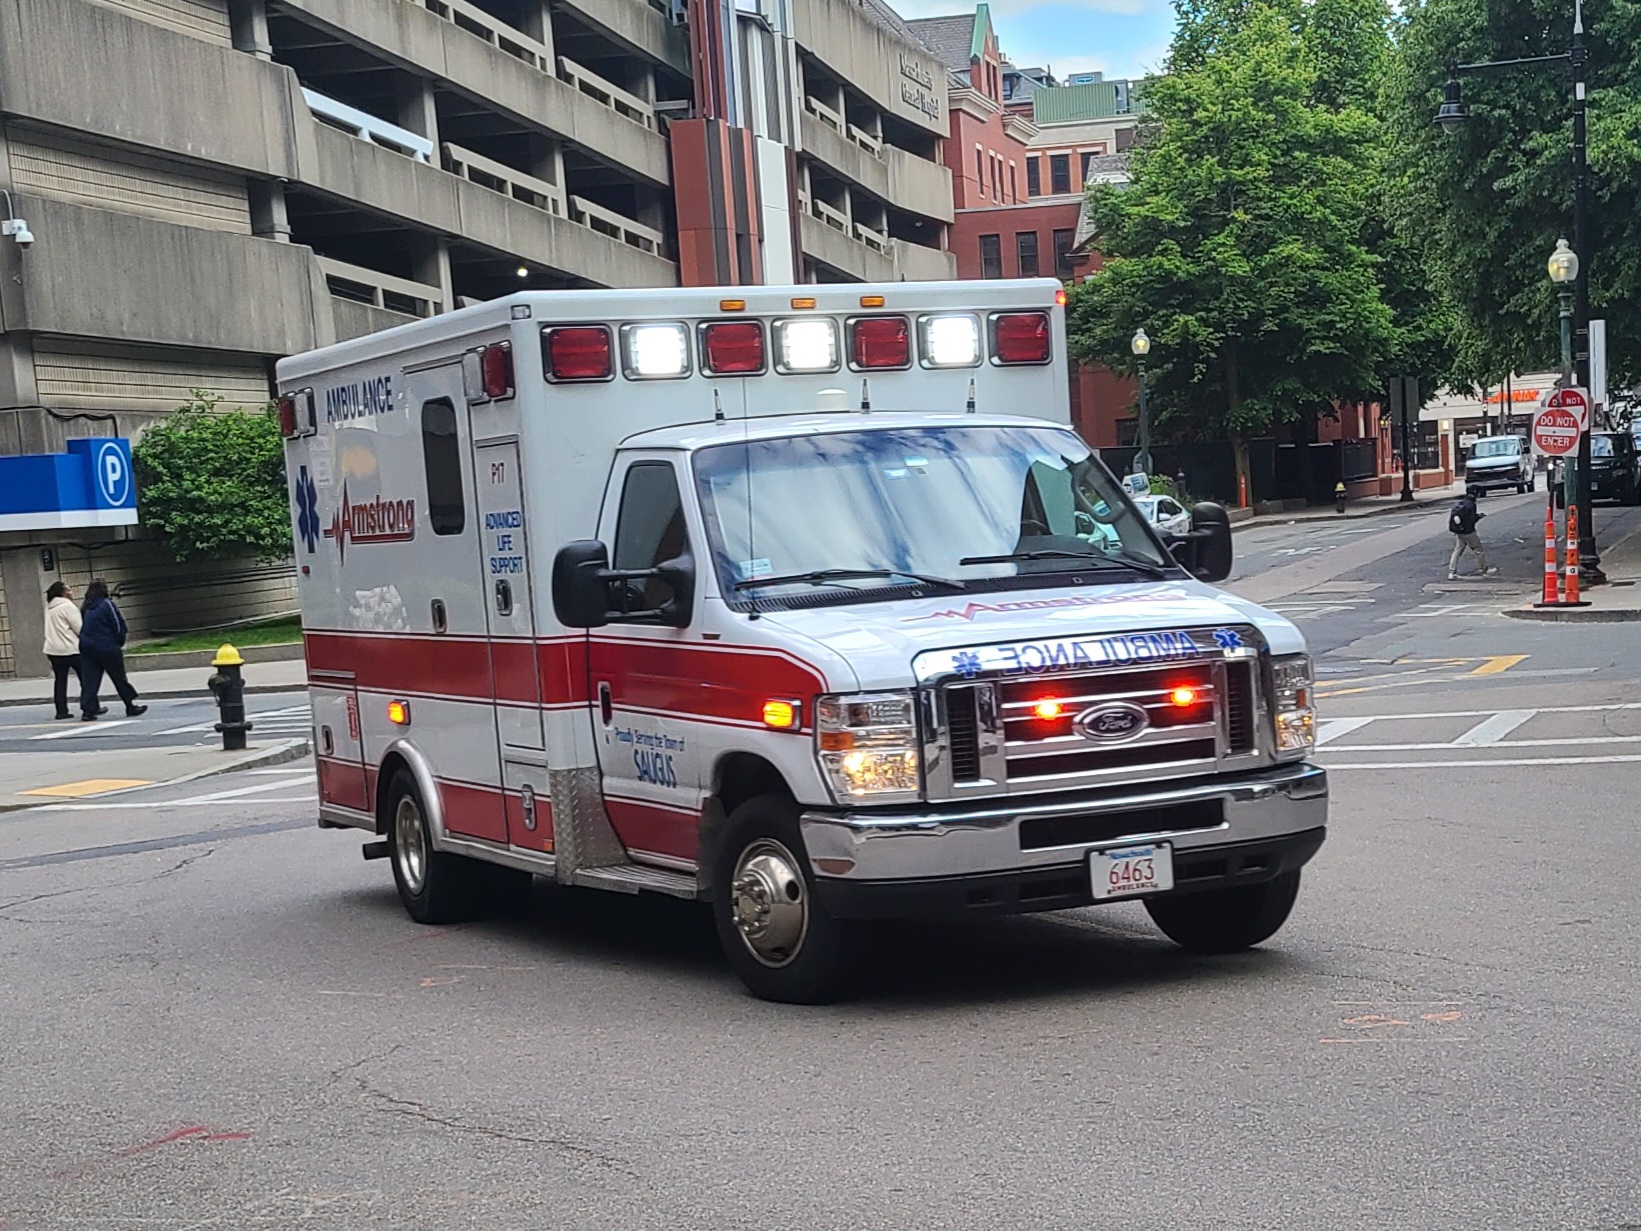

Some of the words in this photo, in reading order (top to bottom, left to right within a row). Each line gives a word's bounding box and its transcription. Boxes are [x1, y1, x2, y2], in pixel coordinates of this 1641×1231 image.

[326, 376, 394, 424] AMBULANCE
[1566, 397, 1581, 405] NOT
[1540, 416, 1553, 426] DO
[1556, 417, 1575, 427] NOT
[1541, 436, 1570, 447] ENTER
[105, 455, 122, 495] P
[341, 478, 415, 545] Armstrong
[485, 511, 521, 530] ADVANCED
[497, 534, 513, 551] LIFE
[490, 556, 523, 574] SUPPORT
[1099, 713, 1133, 731] Ford
[1109, 858, 1155, 885] 6463
